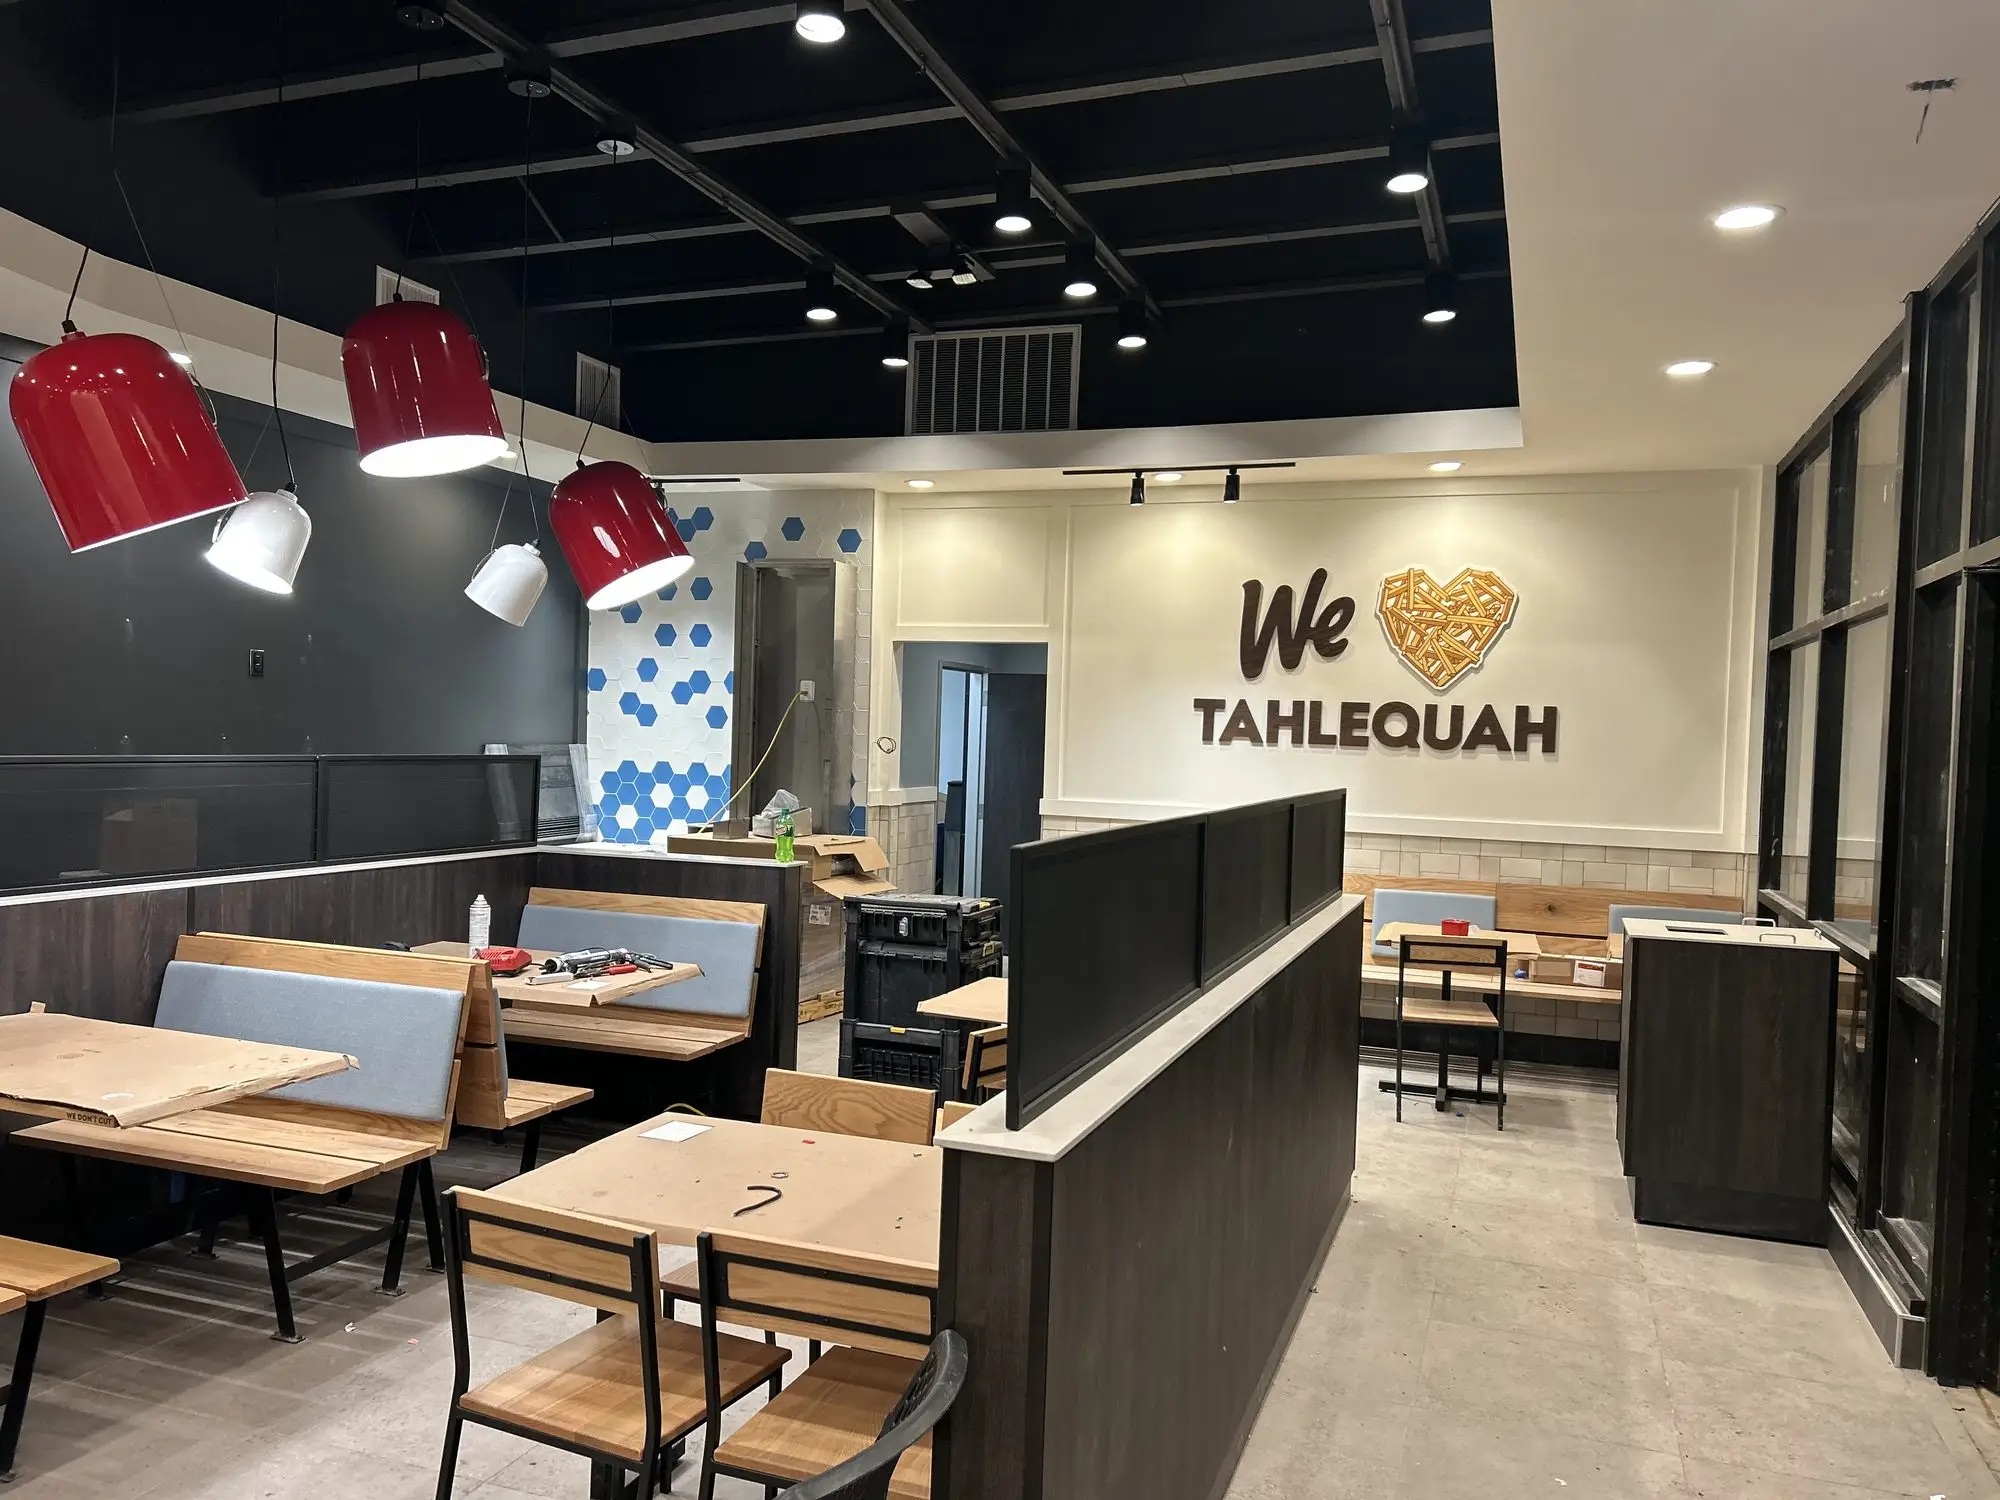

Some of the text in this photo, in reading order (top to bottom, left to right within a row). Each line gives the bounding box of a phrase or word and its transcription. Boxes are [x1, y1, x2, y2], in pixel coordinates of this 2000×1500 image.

[1240, 567, 1356, 679] We
[1193, 698, 1558, 753] TAHLEQUAH
[66, 1112, 76, 1120] WE
[98, 1116, 111, 1125] CUT
